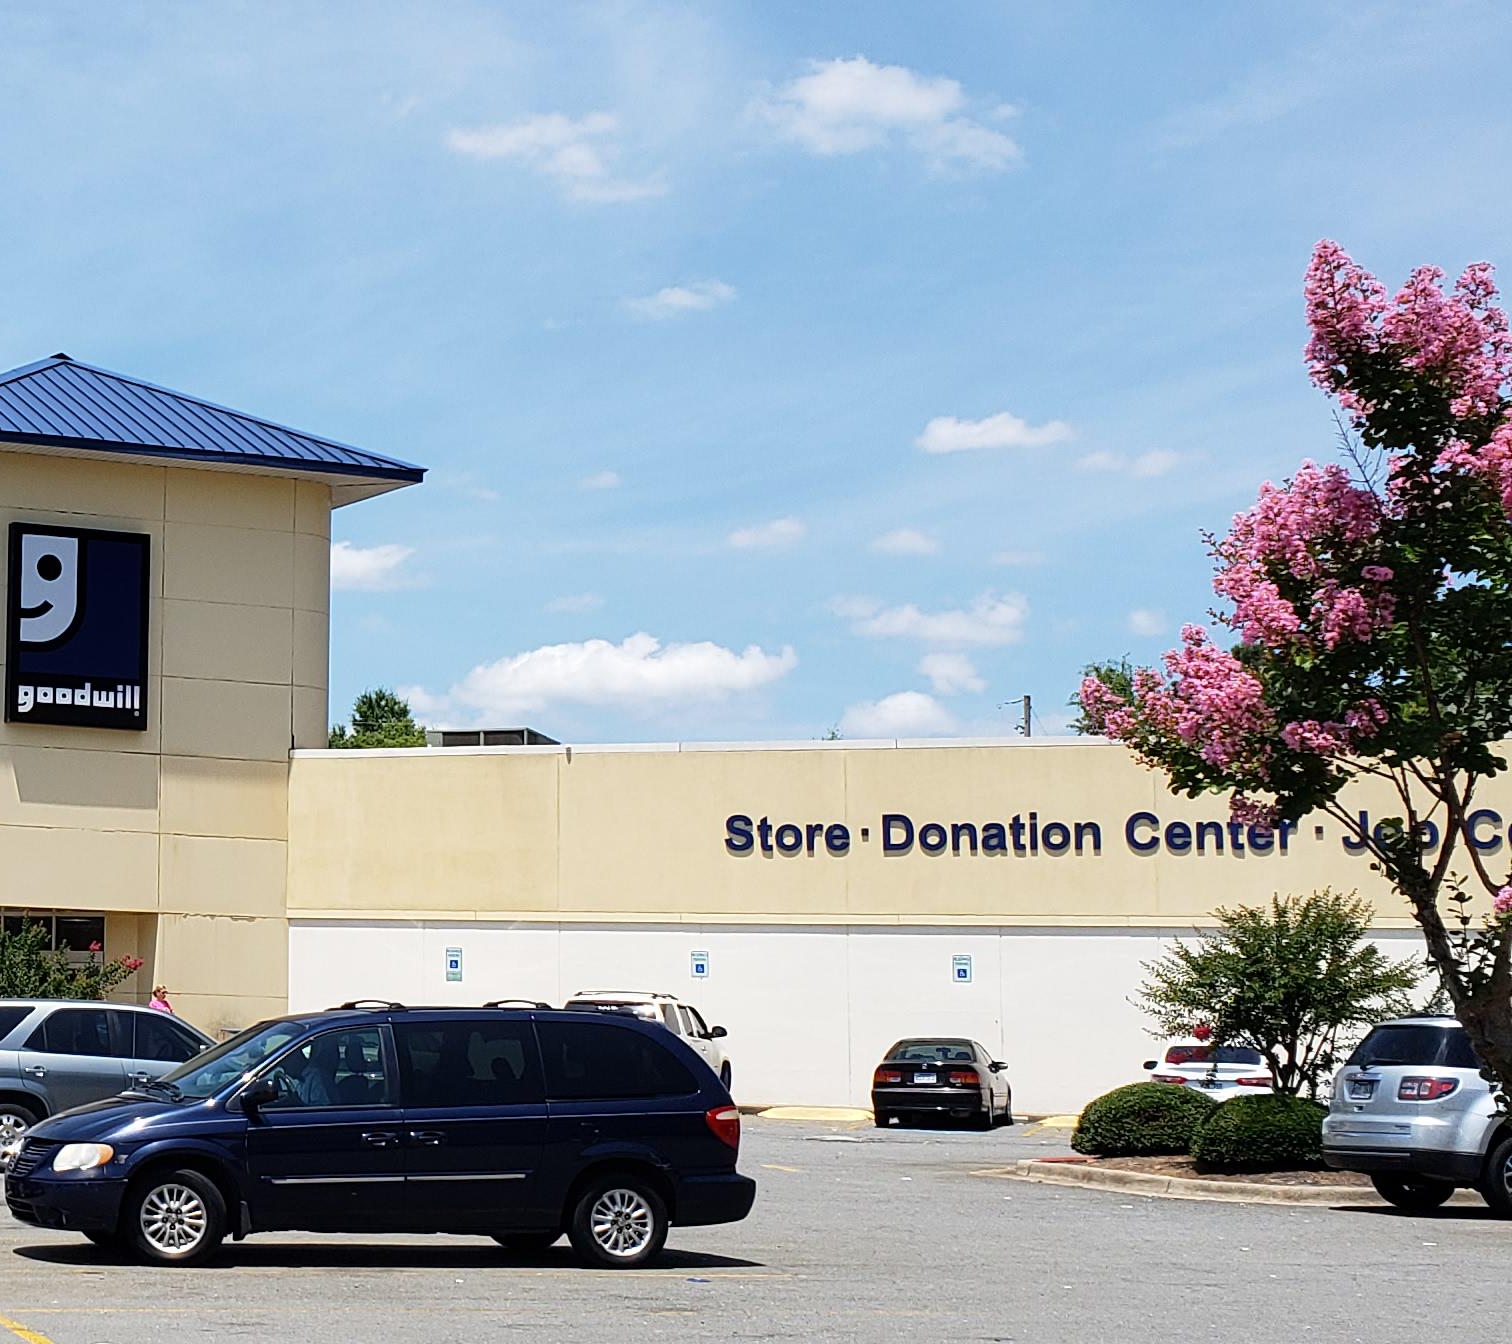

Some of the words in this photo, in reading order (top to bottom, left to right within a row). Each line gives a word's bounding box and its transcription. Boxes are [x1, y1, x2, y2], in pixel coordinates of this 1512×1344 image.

[17, 682, 141, 713] goodwill
[724, 814, 851, 852] Store
[881, 812, 1102, 852] Donation
[1125, 811, 1299, 851] Center
